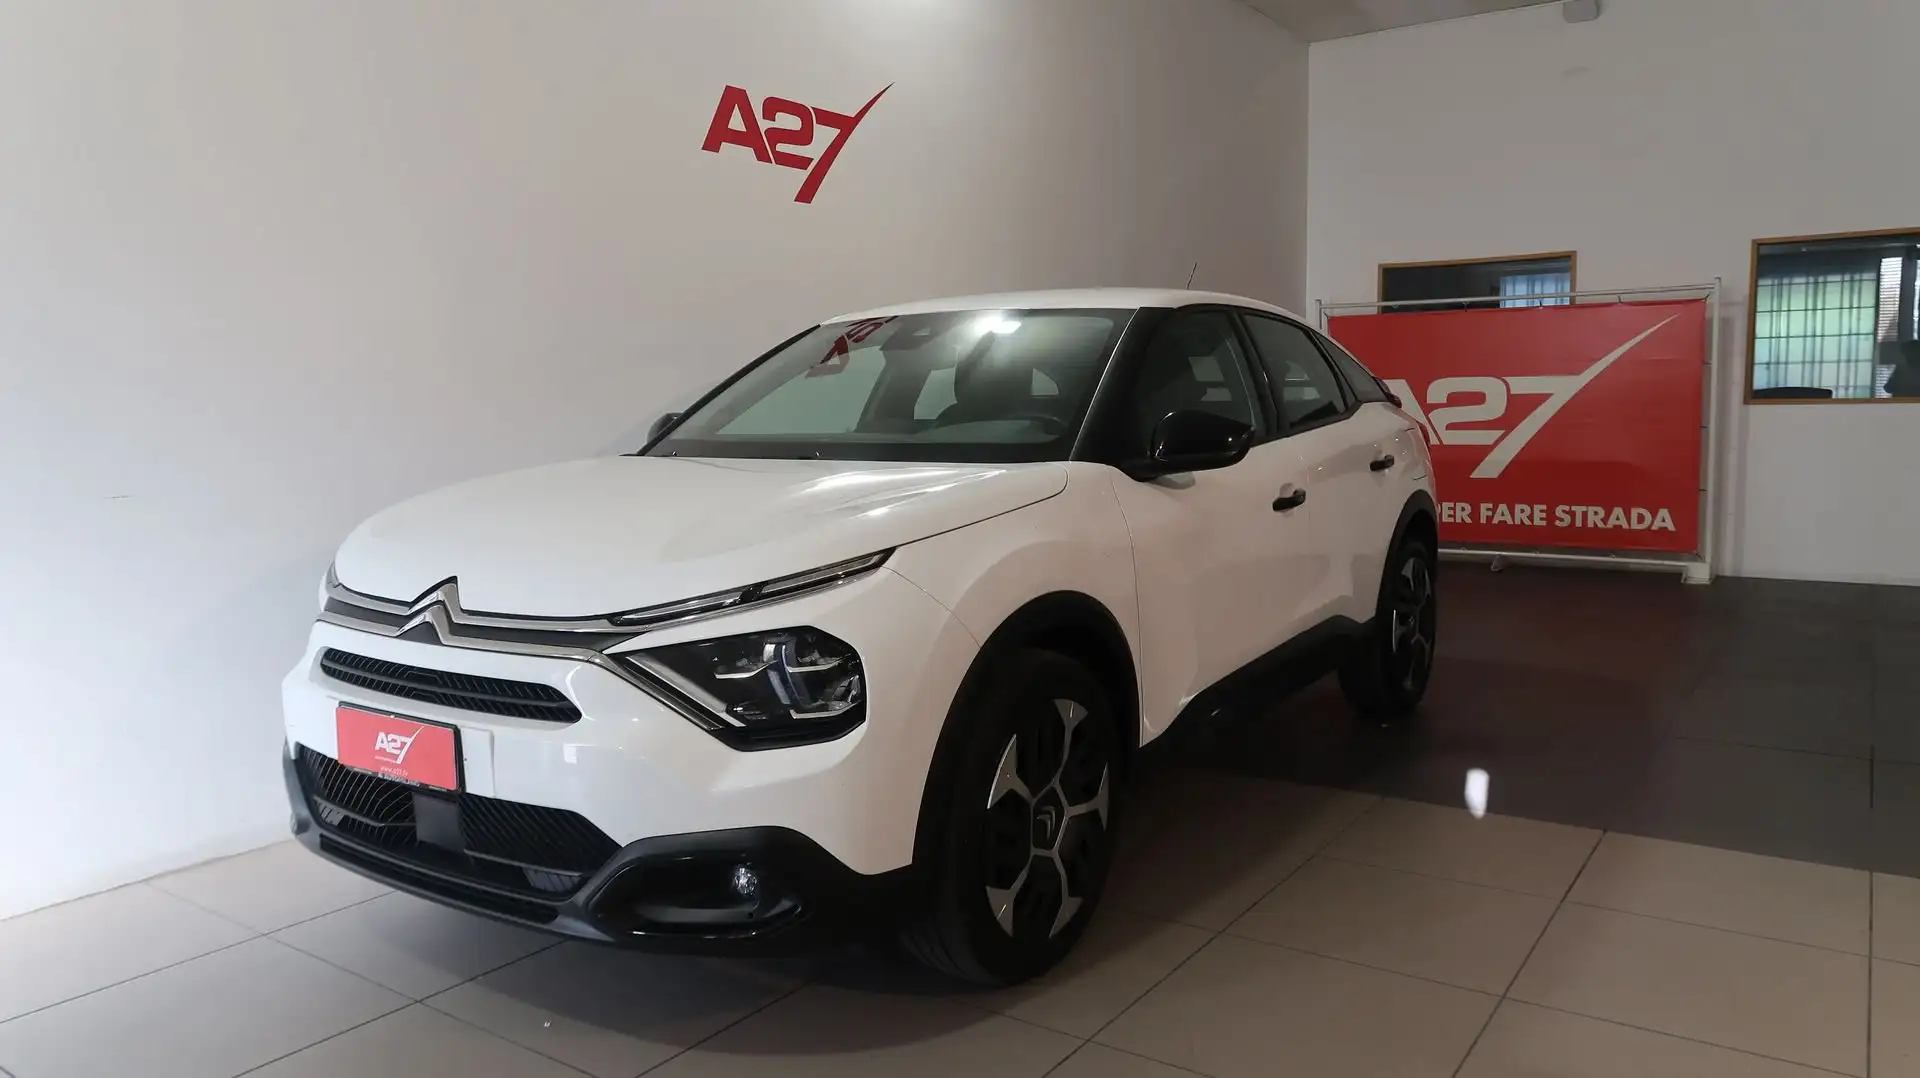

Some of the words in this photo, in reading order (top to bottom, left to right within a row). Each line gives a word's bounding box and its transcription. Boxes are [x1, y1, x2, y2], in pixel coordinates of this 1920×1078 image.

[701, 82, 894, 204] A27
[1438, 502, 1473, 523] ER
[1480, 503, 1547, 526] FARE
[1554, 506, 1676, 532] STRADA
[375, 725, 424, 764] A27
